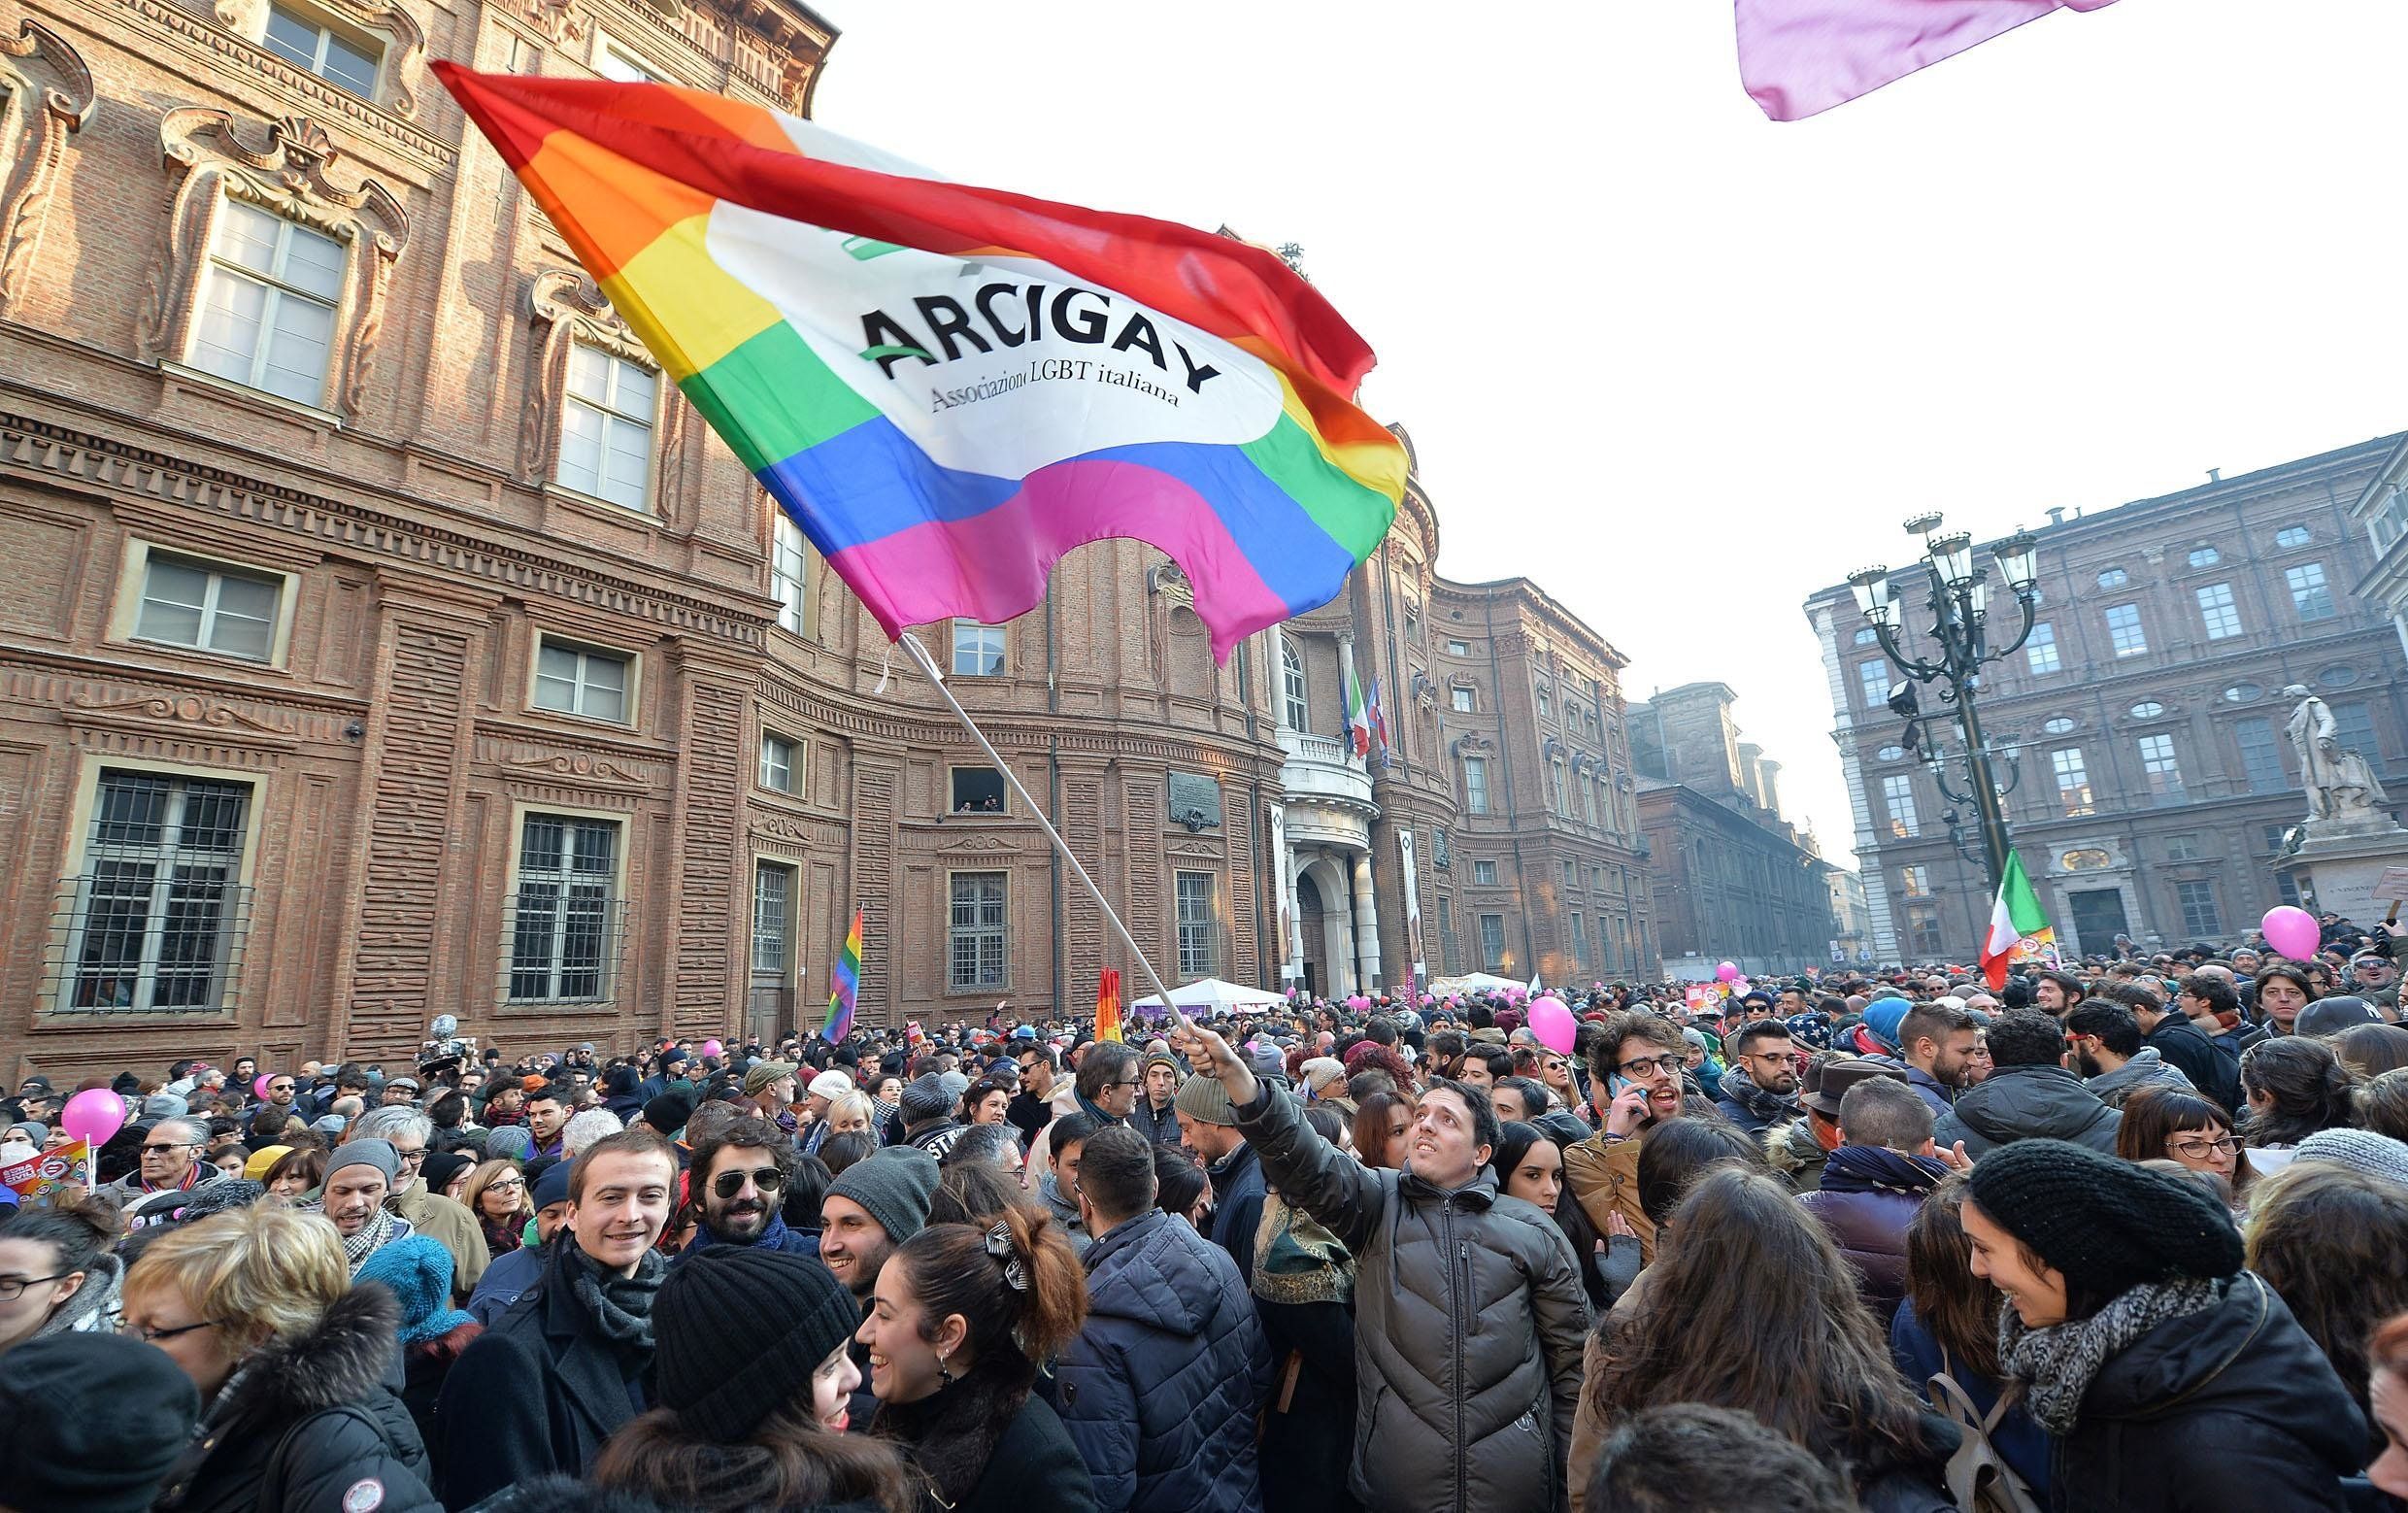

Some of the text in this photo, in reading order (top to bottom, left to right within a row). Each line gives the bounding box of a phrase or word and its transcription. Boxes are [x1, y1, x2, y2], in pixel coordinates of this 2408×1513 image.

[859, 283, 1222, 394] ARCIGAY
[1030, 358, 1093, 383] LGBT
[1098, 363, 1180, 408] italiana
